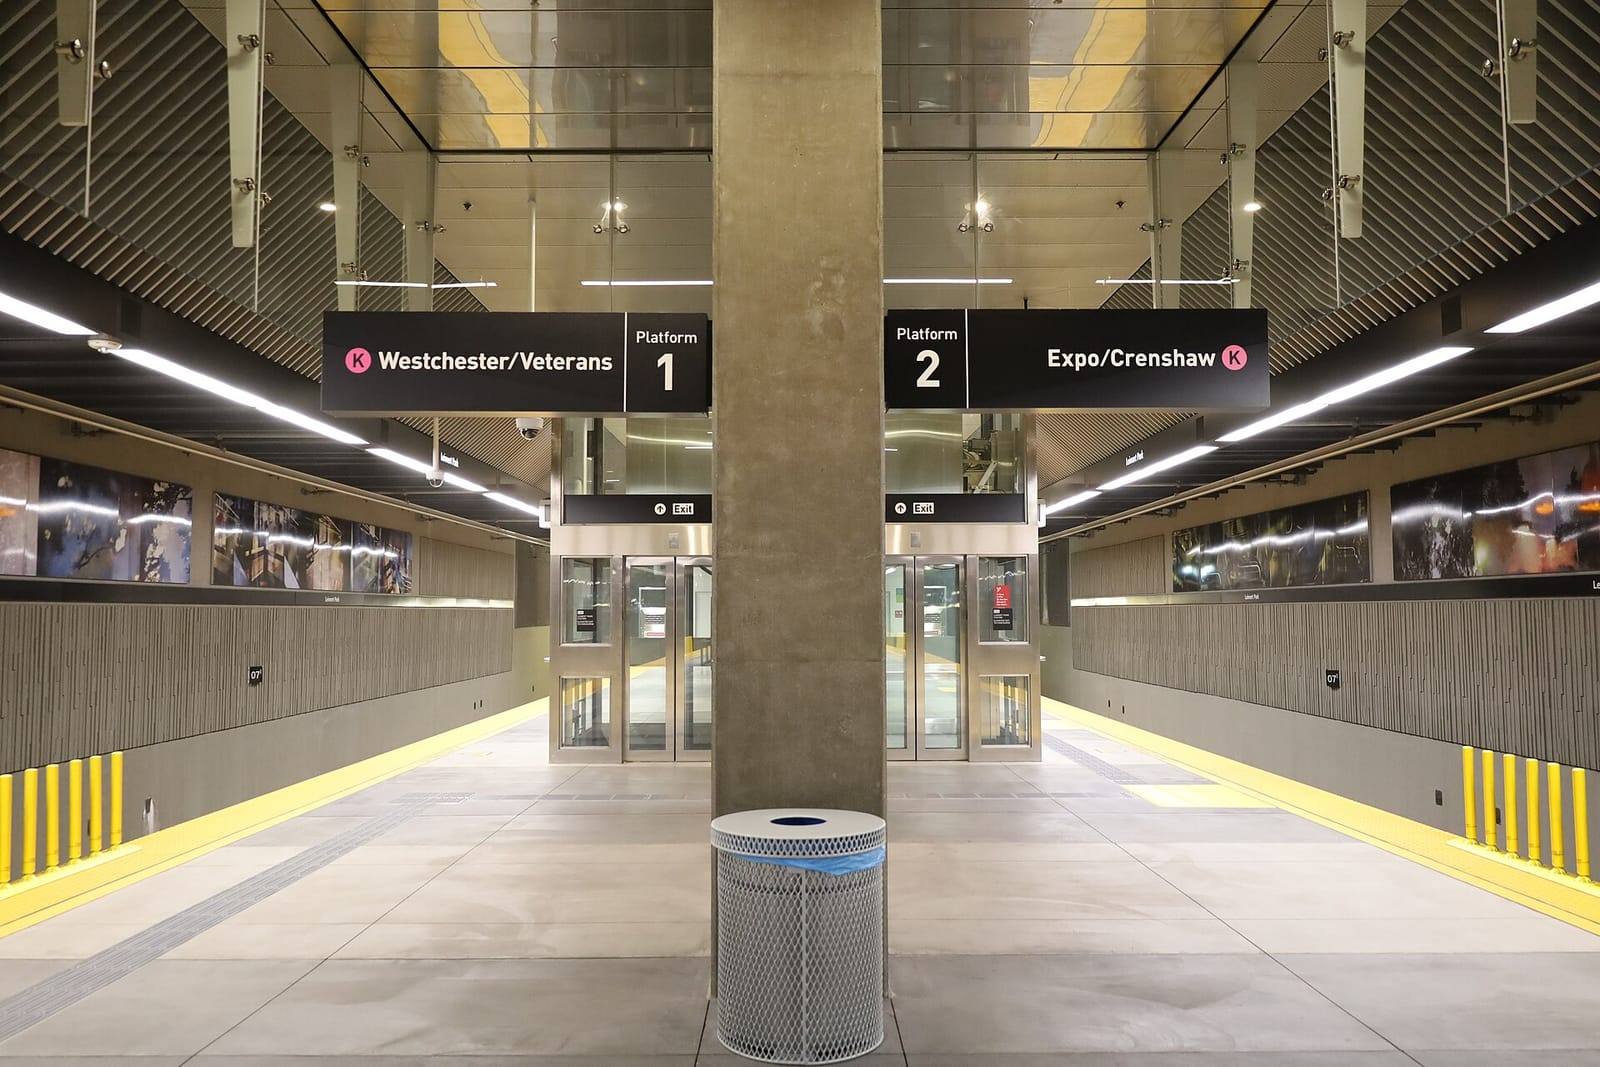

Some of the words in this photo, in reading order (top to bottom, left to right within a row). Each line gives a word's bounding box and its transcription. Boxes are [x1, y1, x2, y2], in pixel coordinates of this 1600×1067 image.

[636, 331, 698, 343] Platform
[897, 328, 958, 340] Platform
[378, 351, 613, 371] Westchester/Veterans
[1048, 348, 1216, 371] Expo/Crenshaw
[657, 353, 673, 391] 1
[916, 349, 940, 388] 2
[675, 504, 692, 513] Exit
[914, 504, 932, 513] Exit
